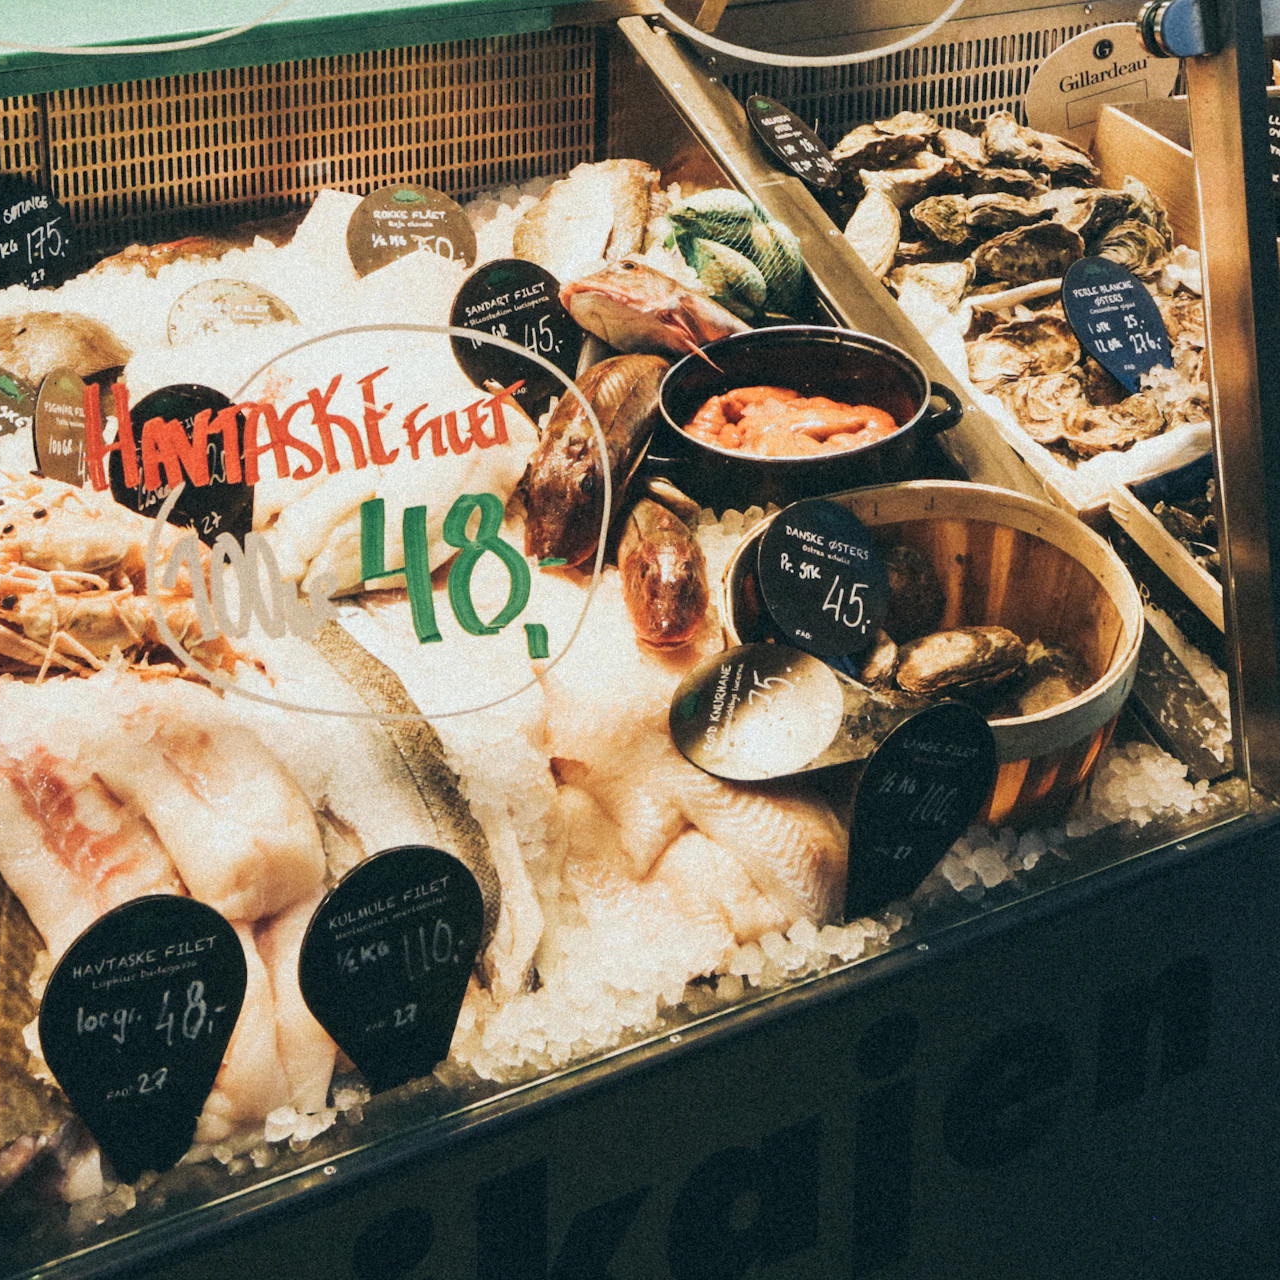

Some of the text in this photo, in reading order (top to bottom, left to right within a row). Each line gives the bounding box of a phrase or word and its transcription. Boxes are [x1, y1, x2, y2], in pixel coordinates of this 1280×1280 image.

[1059, 56, 1149, 94] Gillardeau
[372, 209, 409, 220] ROKKE
[464, 281, 546, 318] SANDART FILET
[1071, 279, 1135, 299] PERLE BLANCHE
[785, 524, 870, 561] DANSKE ØSTERS
[402, 875, 450, 903] FILET
[72, 934, 218, 980] HAVTASKE FILET
